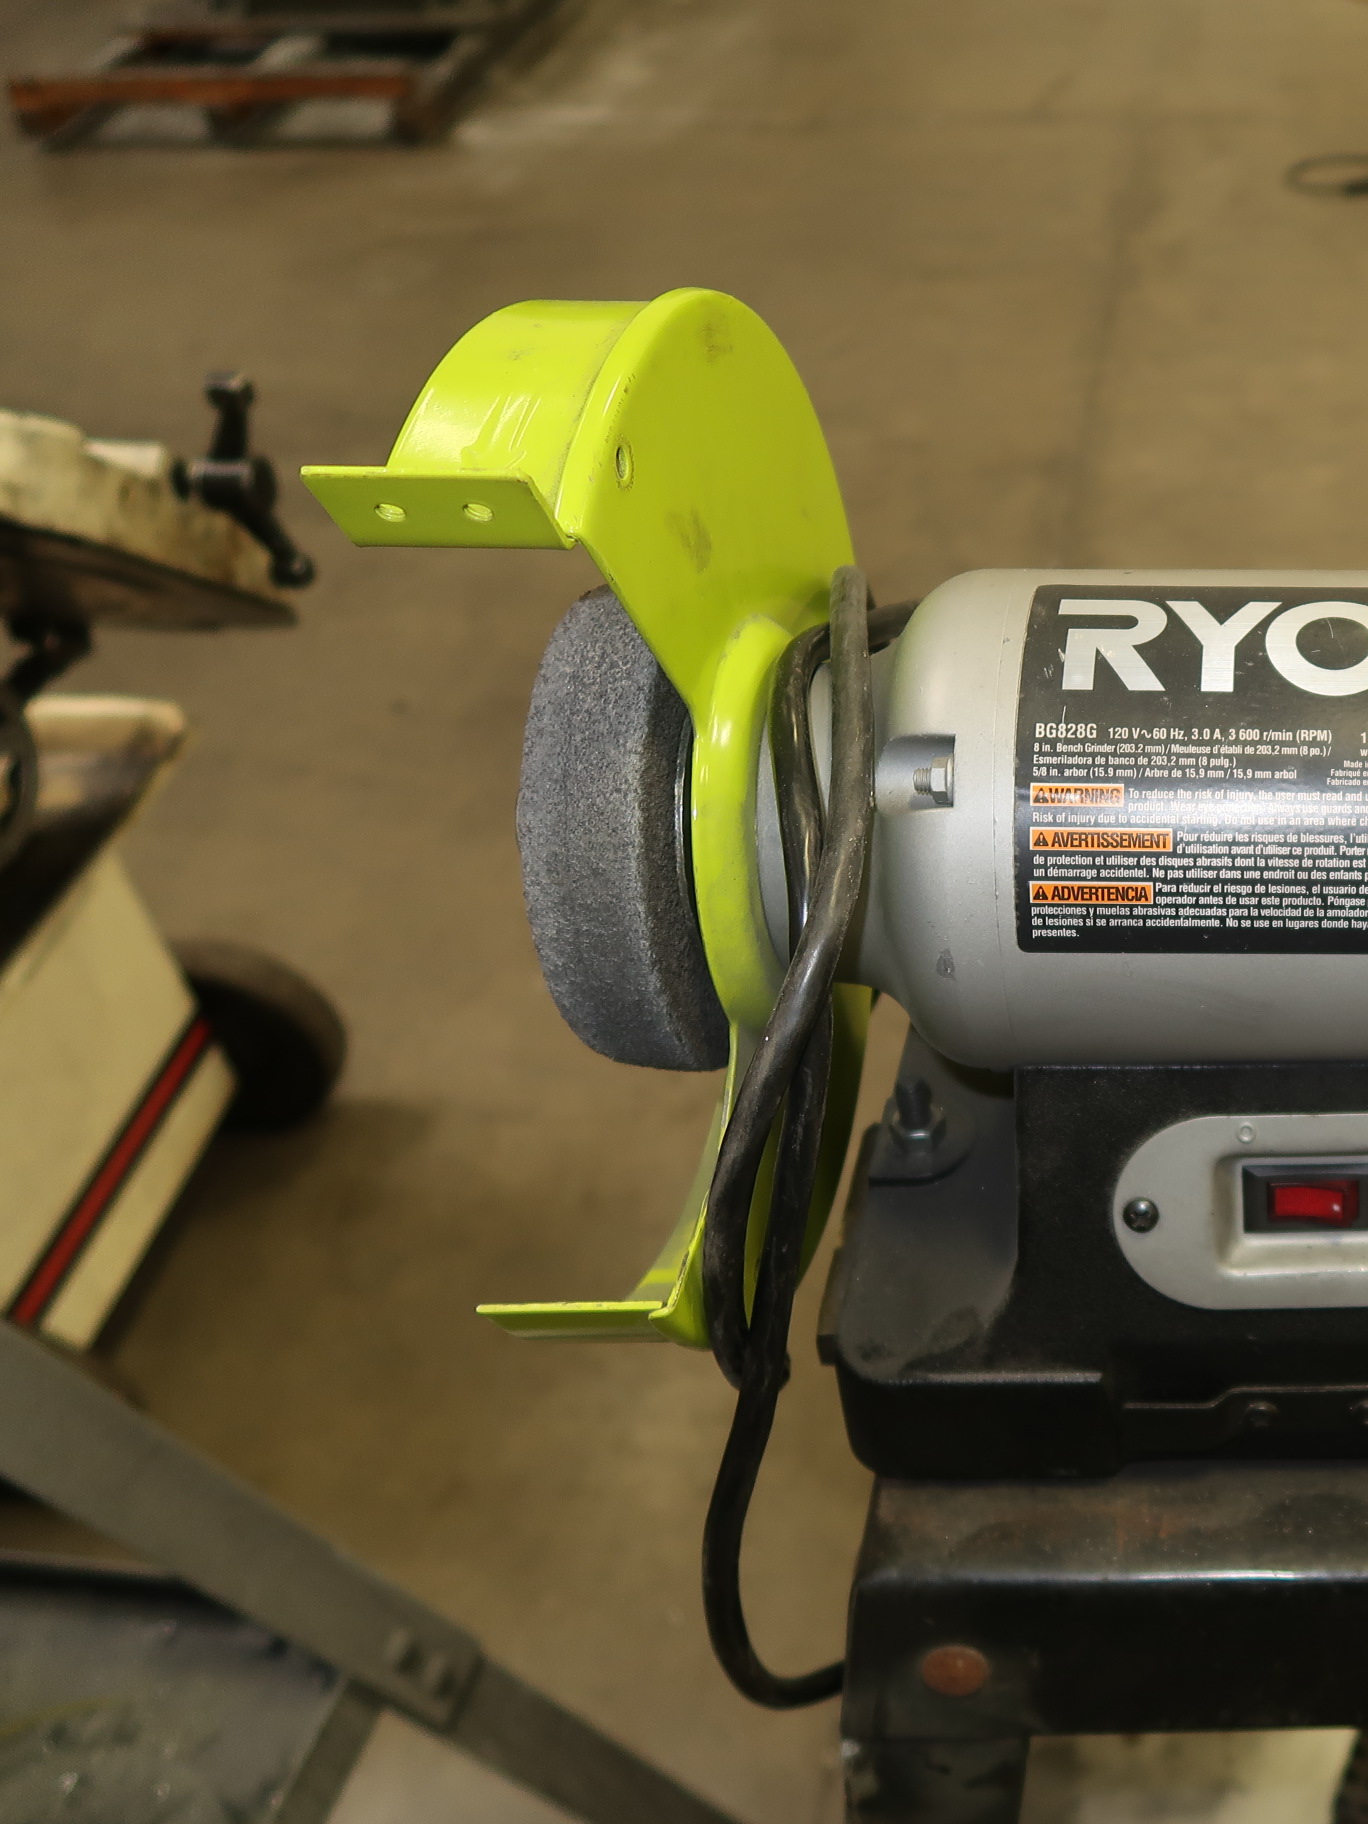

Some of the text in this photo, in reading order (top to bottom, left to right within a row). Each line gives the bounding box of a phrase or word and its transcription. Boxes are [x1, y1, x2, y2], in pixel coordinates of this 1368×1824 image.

[1035, 723, 1097, 738] BG828G
[1108, 728, 1128, 739] 120
[1171, 728, 1187, 741] Hz,
[1192, 728, 1210, 740] 3.0
[1213, 728, 1224, 742] A,
[1263, 729, 1292, 741] r/min
[1296, 729, 1332, 743] (RPM)
[1034, 743, 1039, 752] 8
[1042, 743, 1053, 752] in.
[1057, 744, 1083, 752] Bench
[1085, 744, 1115, 752] Grinder
[1117, 744, 1143, 754] (203.2
[1145, 745, 1164, 754] mm)
[1171, 745, 1210, 753] Meuleuse
[1213, 745, 1242, 754] d'établi
[1245, 745, 1254, 754] de
[1257, 745, 1279, 756] 203,2
[1300, 746, 1308, 756] (8
[1310, 746, 1325, 756] po.)
[1033, 755, 1092, 764] Esmeriladora
[1095, 756, 1105, 764] de
[1109, 756, 1134, 765] banco
[1138, 756, 1148, 765] de
[1151, 756, 1176, 767] 203,2
[1199, 756, 1207, 767] (8
[1210, 757, 1236, 768] pulg.)
[1033, 767, 1047, 776] 5/8
[1050, 768, 1061, 777] in.
[1064, 768, 1088, 777] arbor
[1090, 768, 1114, 778] (15.9
[1116, 768, 1136, 778] mm)
[1145, 768, 1168, 777] Arbre
[1172, 768, 1182, 777] de
[1186, 769, 1204, 779] 15,9
[1233, 769, 1252, 779] 15,9
[1274, 769, 1296, 779] arbol
[1331, 769, 1360, 778] Fabriqué
[1048, 788, 1121, 804] WARNING
[1129, 789, 1138, 798] To
[1142, 789, 1174, 799] reduce
[1178, 789, 1191, 799] the
[1195, 789, 1212, 799] risk
[1215, 790, 1224, 799] of
[1259, 791, 1272, 800] the
[1275, 792, 1295, 800] user
[1299, 792, 1319, 800] must
[1323, 792, 1342, 801] read
[1346, 792, 1362, 801] and
[1051, 832, 1168, 848] AVERTISSEMENT
[1033, 855, 1044, 864] de
[1048, 855, 1092, 866] protection
[1095, 856, 1104, 865] et
[1107, 856, 1137, 865] utiliser
[1140, 856, 1156, 865] des
[1159, 856, 1194, 868] disques
[1197, 857, 1232, 866] abrasifs
[1235, 857, 1254, 867] dont
[1257, 858, 1265, 867] la
[1268, 858, 1299, 867] vitesse
[1302, 858, 1312, 867] de
[1316, 858, 1350, 867] rotation
[1353, 859, 1366, 868] est
[1051, 886, 1148, 901] ADVERTENCIA
[1032, 906, 1086, 915] protecciones
[1089, 908, 1094, 916] y
[1097, 906, 1129, 915] muelas
[1133, 907, 1175, 915] abrasivas
[1179, 907, 1227, 916] adecuadas
[1229, 909, 1248, 917] para
[1251, 908, 1258, 917] la
[1261, 908, 1301, 917] velocidad
[1304, 908, 1314, 917] de
[1317, 908, 1324, 917] la
